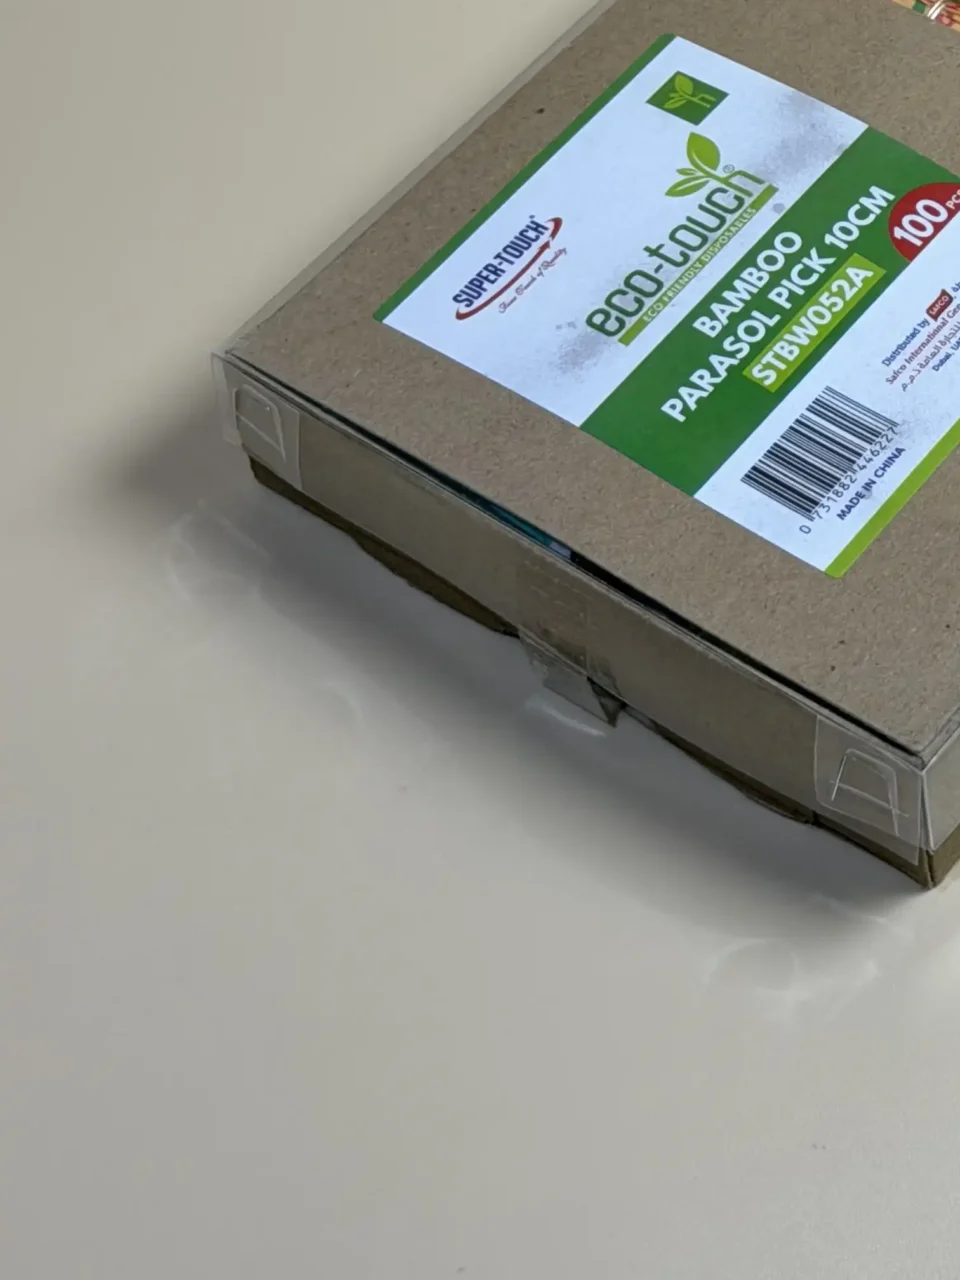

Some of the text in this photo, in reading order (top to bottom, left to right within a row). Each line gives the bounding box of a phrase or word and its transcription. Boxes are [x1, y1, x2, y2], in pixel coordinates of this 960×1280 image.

[585, 165, 766, 338] eco-touch
[893, 199, 949, 247] 100
[452, 220, 549, 308] SUPER-TOUCH
[515, 275, 537, 296] Touch
[537, 266, 545, 278] of
[541, 247, 567, 271] Quality
[643, 207, 757, 322] ECO FRIENDLY DISPOSABLES
[692, 231, 803, 338] BAMBOO
[660, 185, 896, 423] PARASOL PICK 10CM
[751, 266, 874, 386] STBW052A
[928, 295, 950, 315] SAFCO
[881, 317, 931, 367] Distributed by
[885, 363, 908, 385] Safco
[903, 316, 950, 365] International
[916, 344, 943, 370] العامة
[931, 351, 955, 372] Dubai,
[798, 426, 899, 535] 0 731882 446227
[836, 447, 906, 521] MADE IN CHINA
